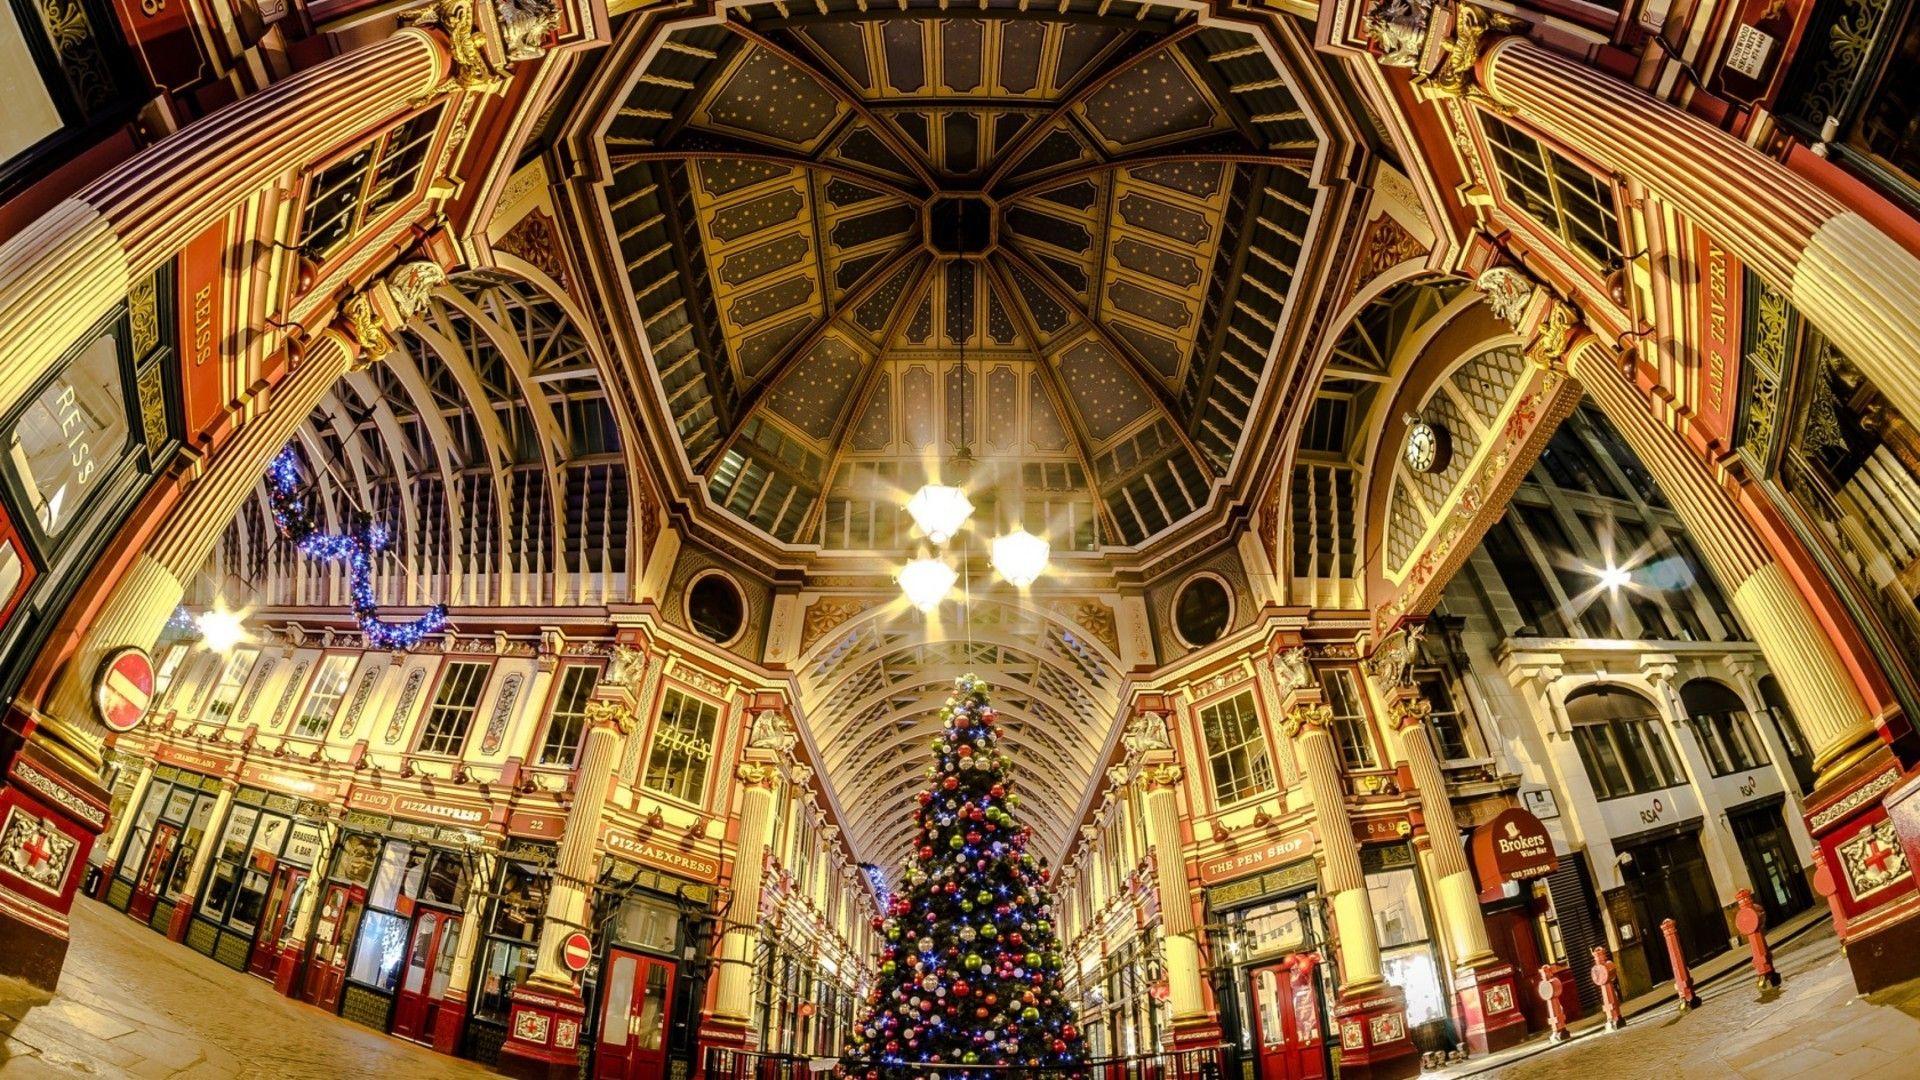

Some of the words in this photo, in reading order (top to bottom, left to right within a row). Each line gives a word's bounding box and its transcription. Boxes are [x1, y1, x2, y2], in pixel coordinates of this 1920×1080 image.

[1737, 29, 1758, 71] SECURITY
[1709, 240, 1727, 345] TAVERN
[195, 282, 211, 366] REISS
[1709, 350, 1726, 414] LAMB
[56, 385, 95, 484] REISS
[659, 728, 711, 760] LUC'S
[364, 794, 389, 806] LUC'S
[400, 800, 483, 822] PIZZAEXPRESS
[530, 819, 544, 830] 22
[1367, 823, 1375, 834] 8
[1377, 823, 1386, 833] &
[1388, 821, 1396, 832] 9
[300, 846, 312, 857] BAR
[610, 834, 713, 874] PIZZAEXPRESS
[1209, 860, 1234, 875] THE
[1236, 851, 1264, 867] PEN
[1266, 839, 1303, 858] SHOP
[1498, 833, 1545, 854] Brokers
[1520, 849, 1537, 858] Wine
[1536, 846, 1548, 855] Bar
